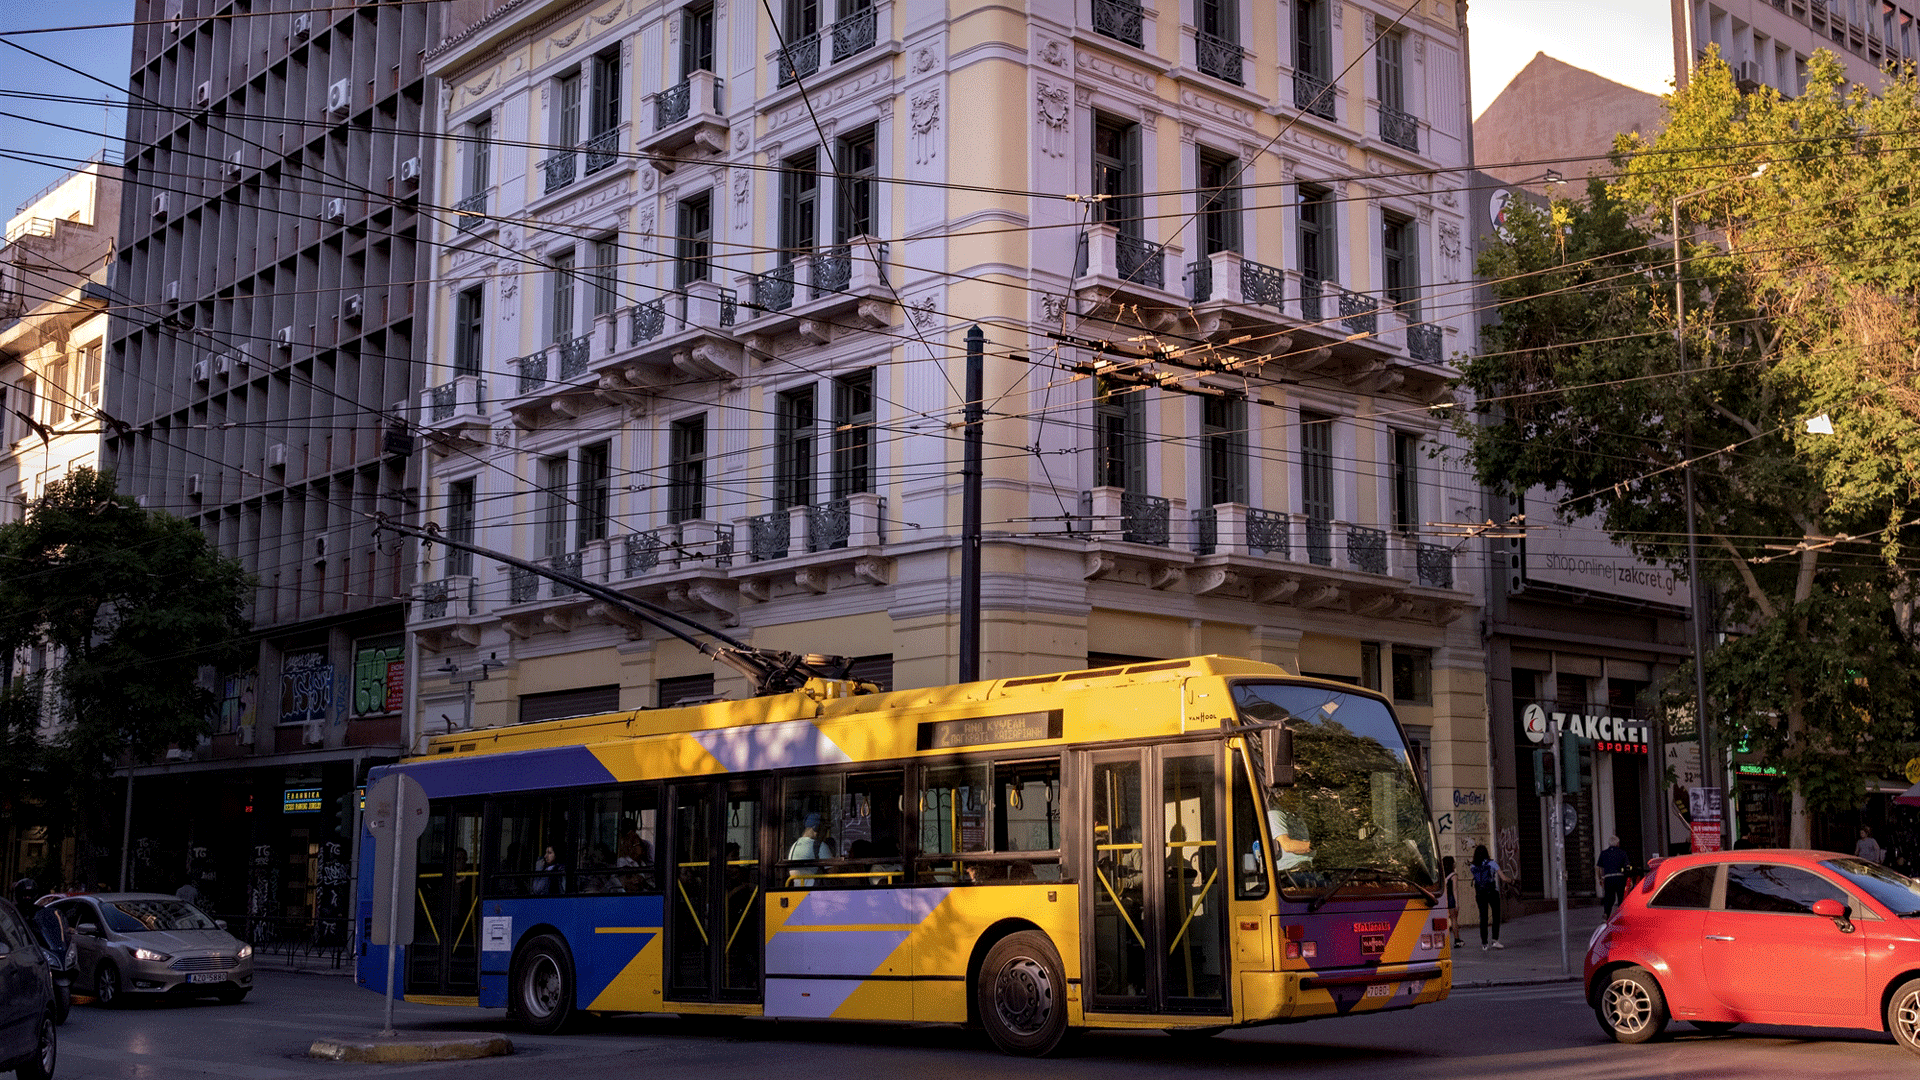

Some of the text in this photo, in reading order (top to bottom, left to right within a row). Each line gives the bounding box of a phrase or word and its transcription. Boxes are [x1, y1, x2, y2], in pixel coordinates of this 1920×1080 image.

[1546, 552, 1576, 576] shop
[1578, 559, 1612, 579] online
[940, 725, 950, 747] 2
[1598, 742, 1648, 754] SPORTS
